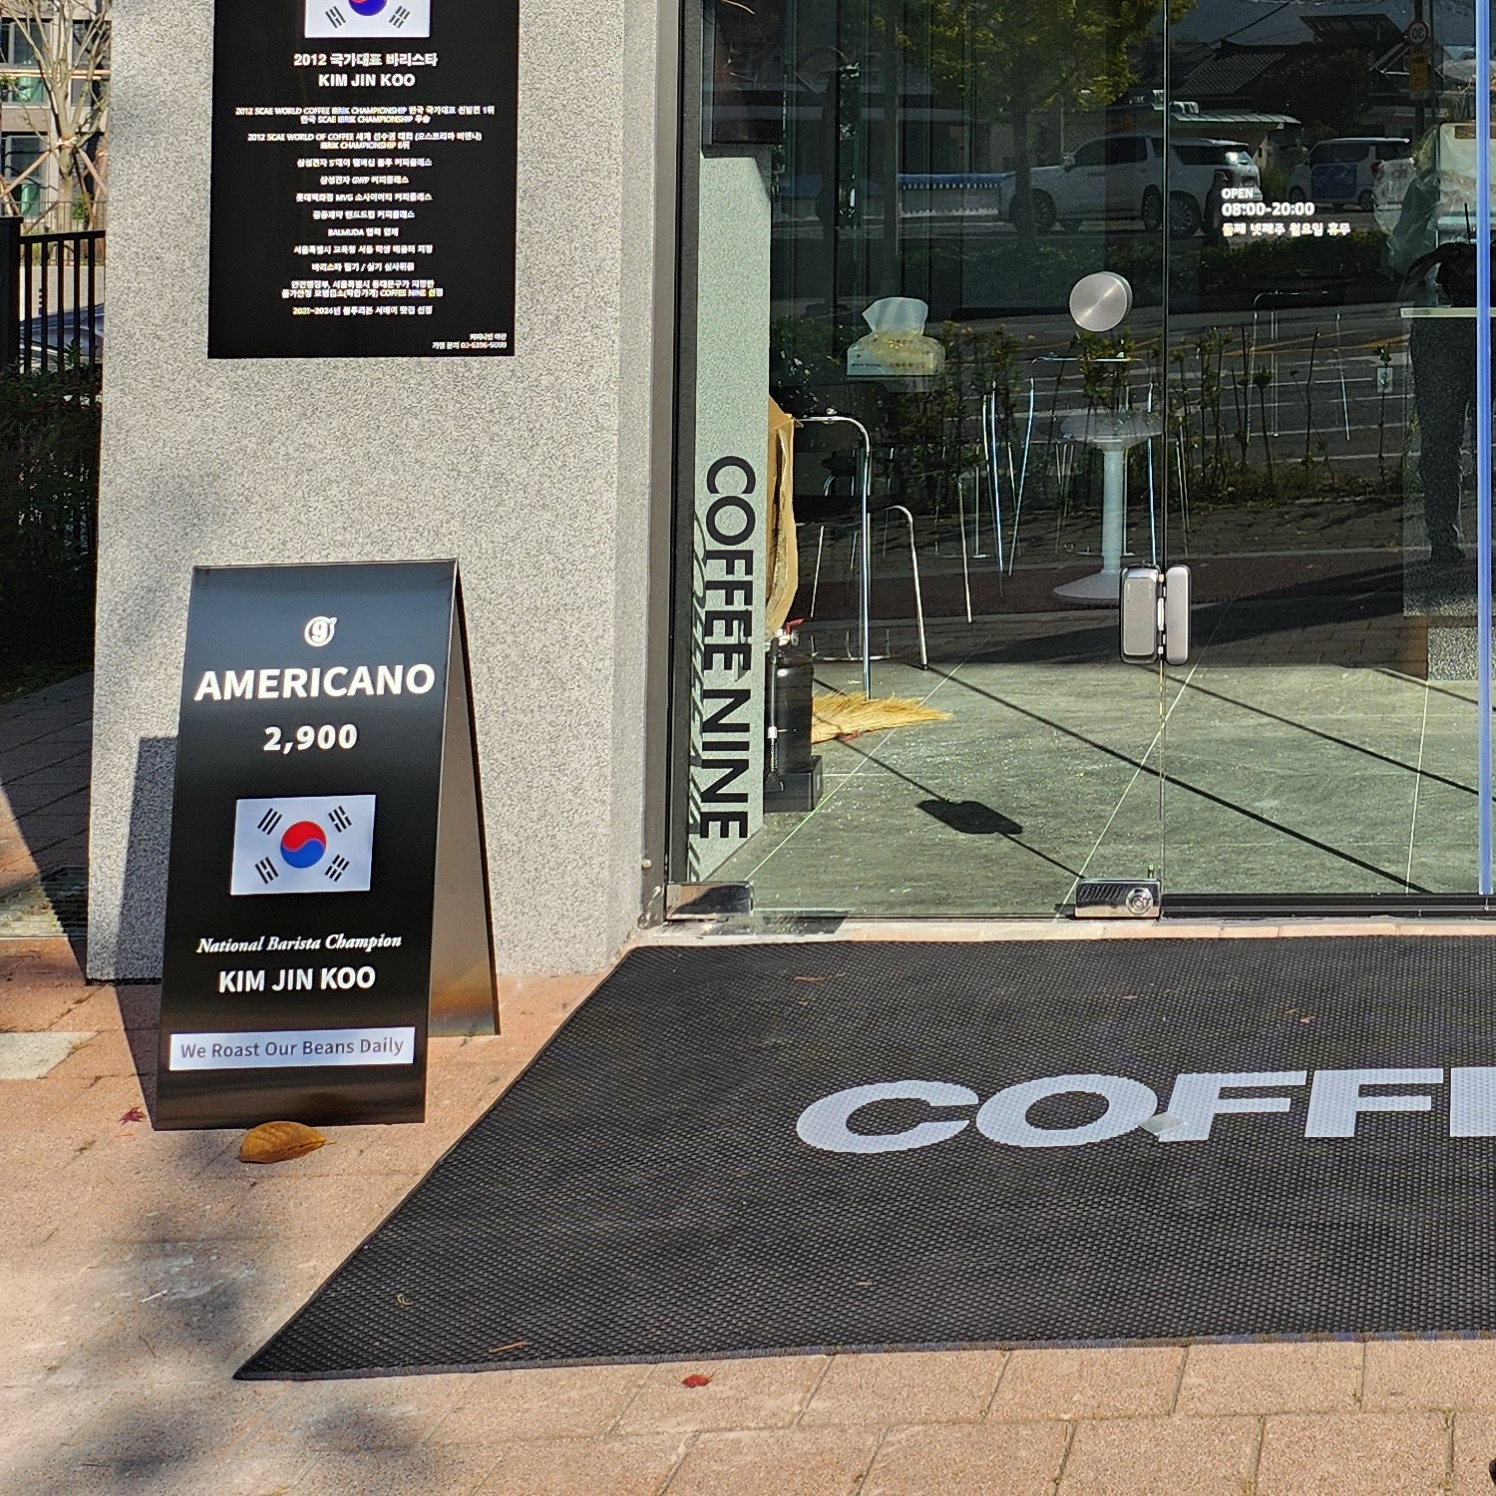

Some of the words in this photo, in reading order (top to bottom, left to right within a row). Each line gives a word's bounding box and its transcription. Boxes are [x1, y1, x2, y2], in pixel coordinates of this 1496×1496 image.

[294, 54, 327, 67] 2012
[330, 53, 383, 67] 국가대표
[386, 53, 438, 67] 바리스타
[318, 74, 348, 87] KIM
[351, 74, 376, 87] JIN
[380, 74, 416, 87] KOO
[235, 106, 253, 115] 2012
[275, 106, 302, 115] WORLD
[303, 106, 330, 115] COFFEE
[248, 132, 265, 141] 2012
[287, 132, 314, 141] WORLD
[316, 132, 326, 141] OF
[328, 132, 354, 141] COFFEE
[1221, 188, 1254, 200] OPEN
[1221, 202, 1315, 217] 08:00-20:00
[1289, 223, 1324, 238] 월요일
[1327, 222, 1351, 236] 휴무
[703, 455, 757, 672] COFFEE
[194, 663, 436, 702] AMERICANO
[263, 723, 358, 755] 2,900
[699, 688, 752, 839] NINE
[196, 935, 263, 954] National
[267, 934, 321, 953] Barista
[325, 932, 402, 953] Champion
[219, 969, 265, 993] KIM
[271, 968, 314, 991] JIN
[320, 966, 376, 990] KOO
[181, 1042, 206, 1059] We
[211, 1041, 260, 1058] Roast
[265, 1040, 297, 1057] Our
[302, 1038, 354, 1056] Beans
[360, 1035, 404, 1059] Daily
